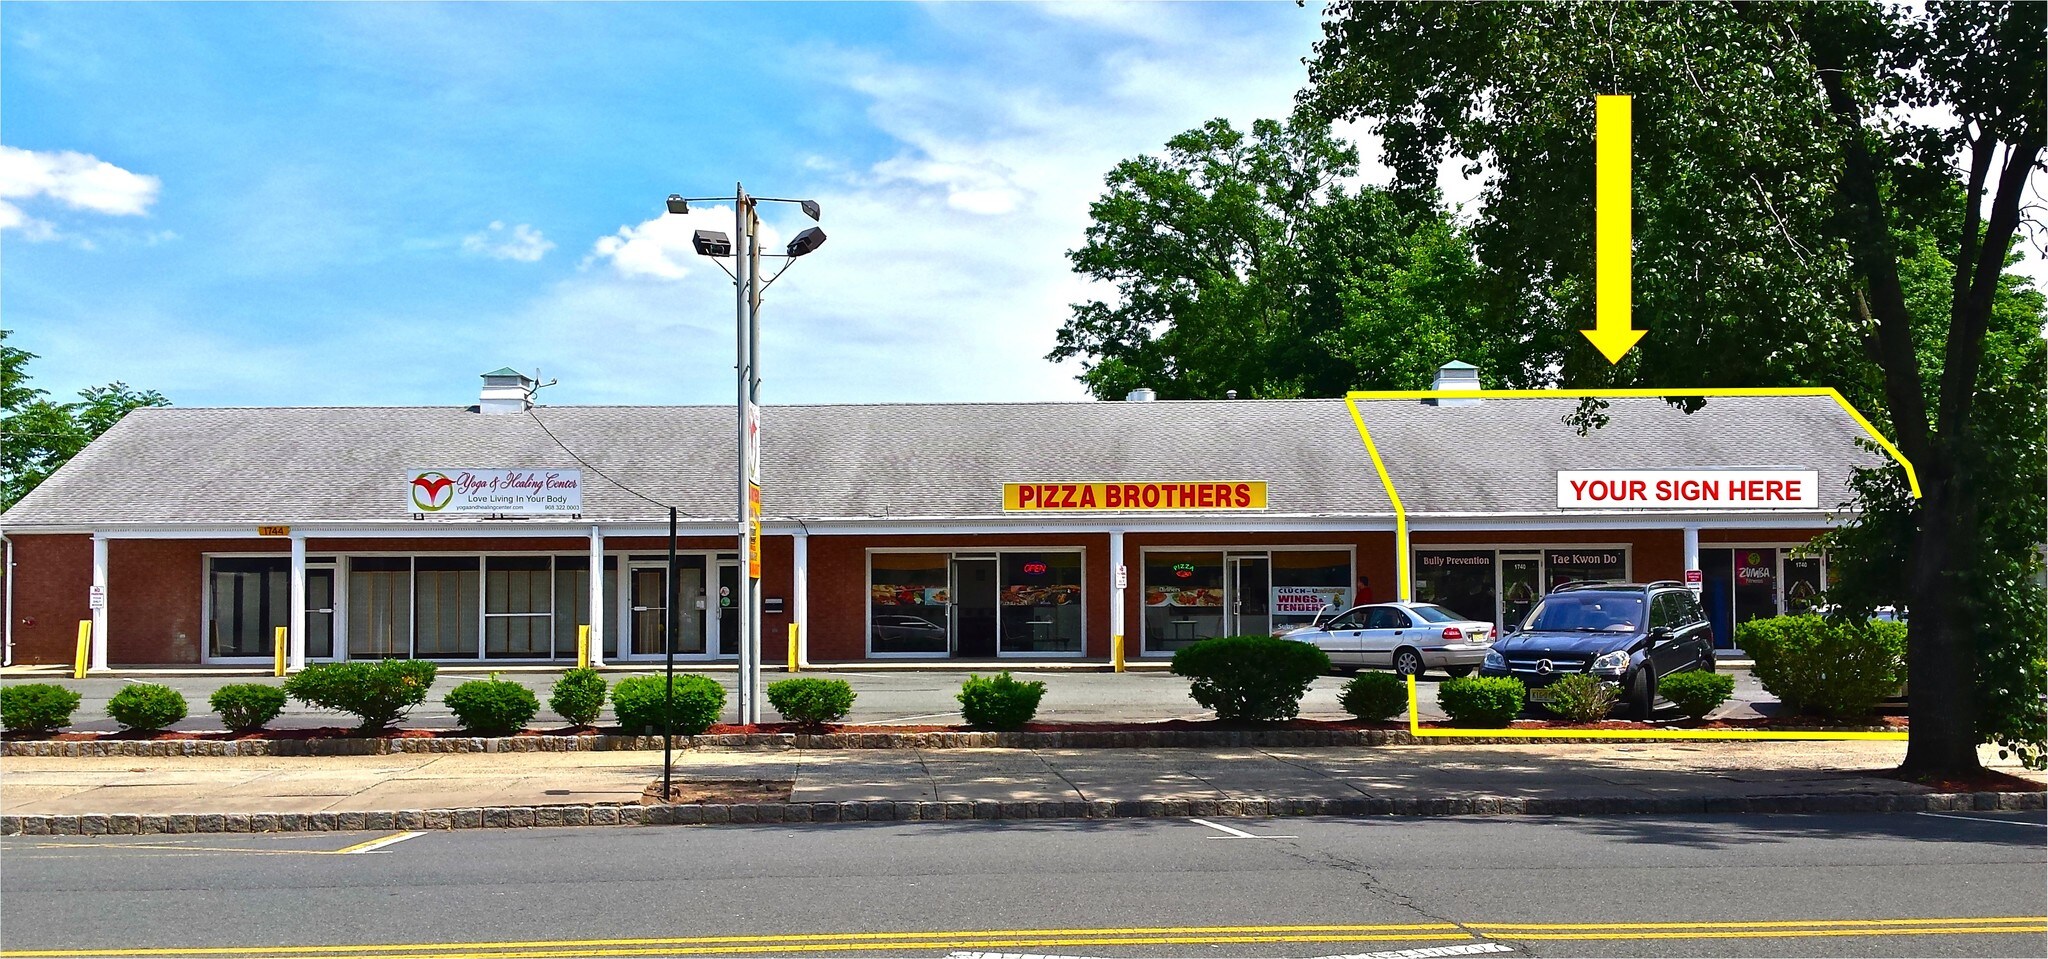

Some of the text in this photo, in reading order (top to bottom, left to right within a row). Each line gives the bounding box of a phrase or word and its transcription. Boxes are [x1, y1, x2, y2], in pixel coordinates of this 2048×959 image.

[456, 470, 578, 495] Yoga & Healing Center
[468, 495, 568, 504] Love Living In Your Body
[1018, 484, 1251, 508] PIZZA BROTHERS
[263, 526, 284, 536] 1744
[1423, 556, 1490, 566] Bully Prevention
[1552, 554, 1617, 564] Tae Kwon Do
[1024, 564, 1047, 573] OPEN
[1173, 563, 1195, 571] PIZZA
[1739, 567, 1770, 578] ZUMBA
[1277, 595, 1318, 603] WINGS
